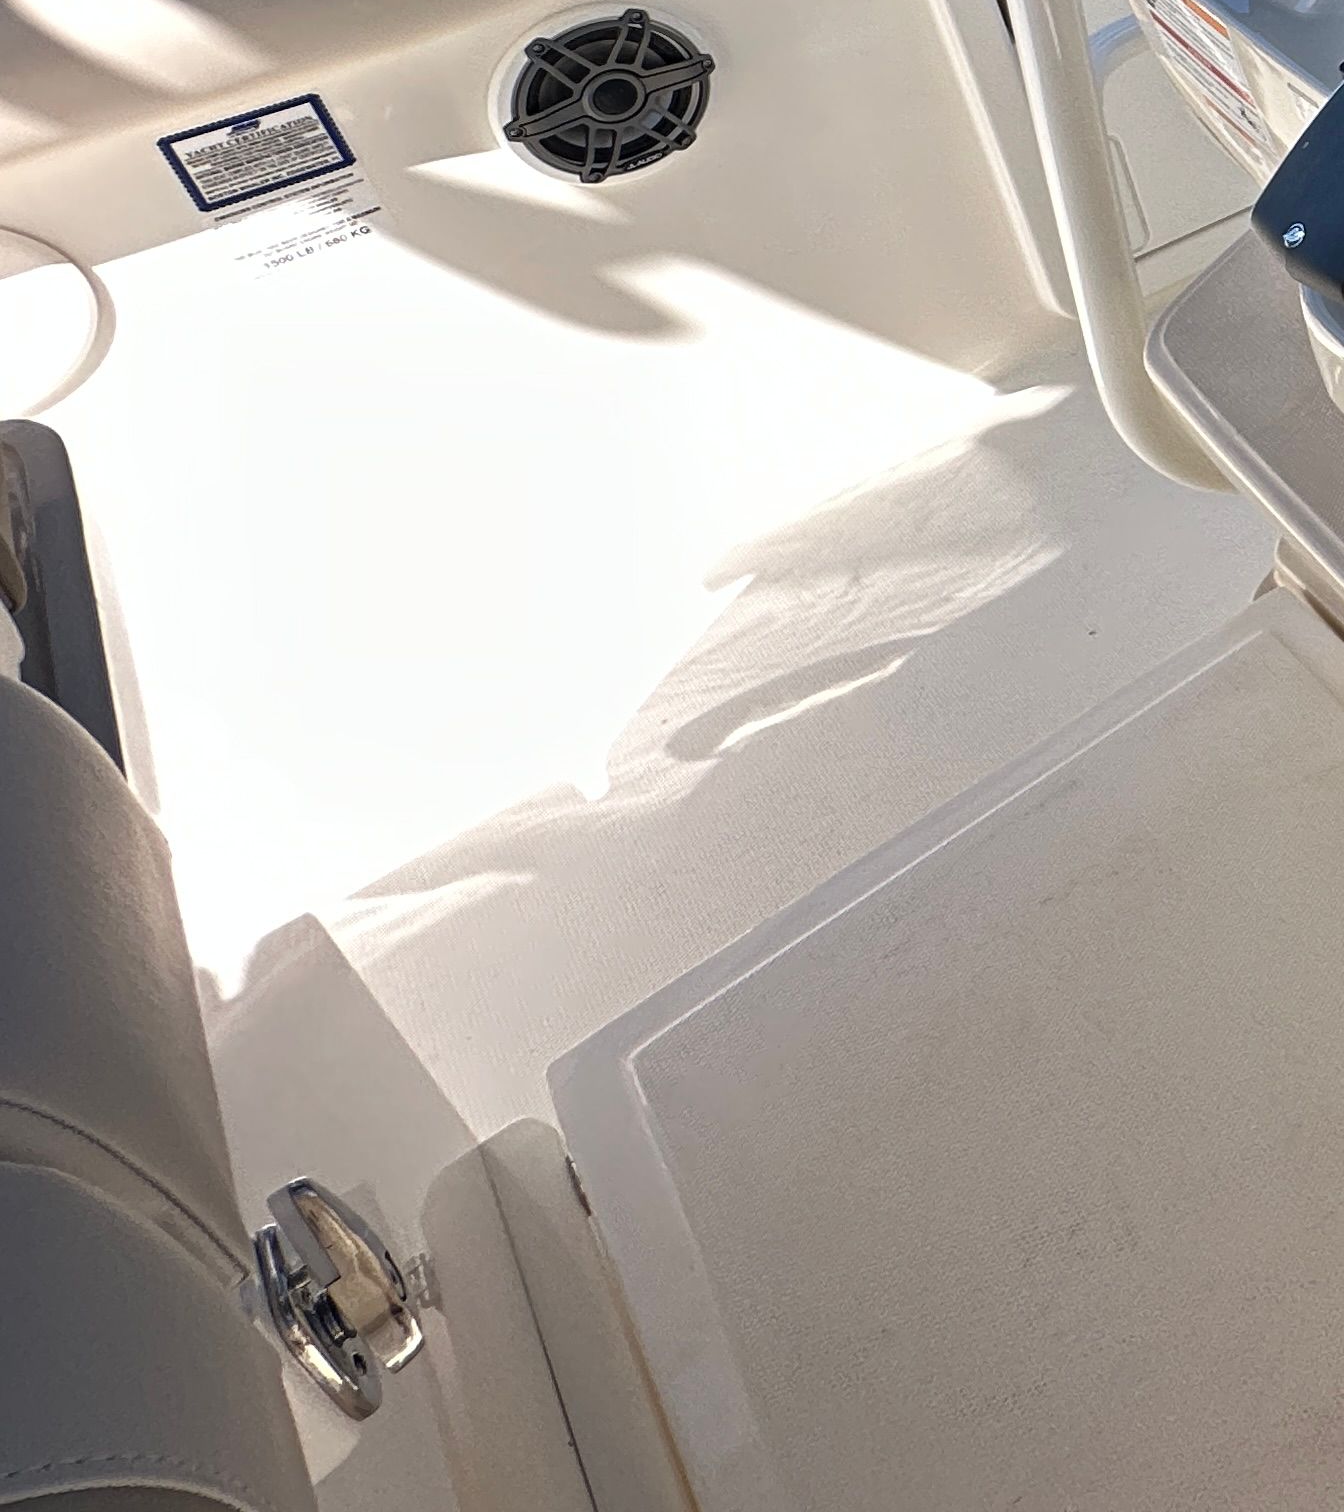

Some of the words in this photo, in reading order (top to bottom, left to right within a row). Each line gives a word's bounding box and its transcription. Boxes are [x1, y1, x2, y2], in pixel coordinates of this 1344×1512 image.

[184, 141, 224, 159] YACHT
[227, 115, 314, 148] CERTIFICATION
[350, 225, 371, 238] KG
